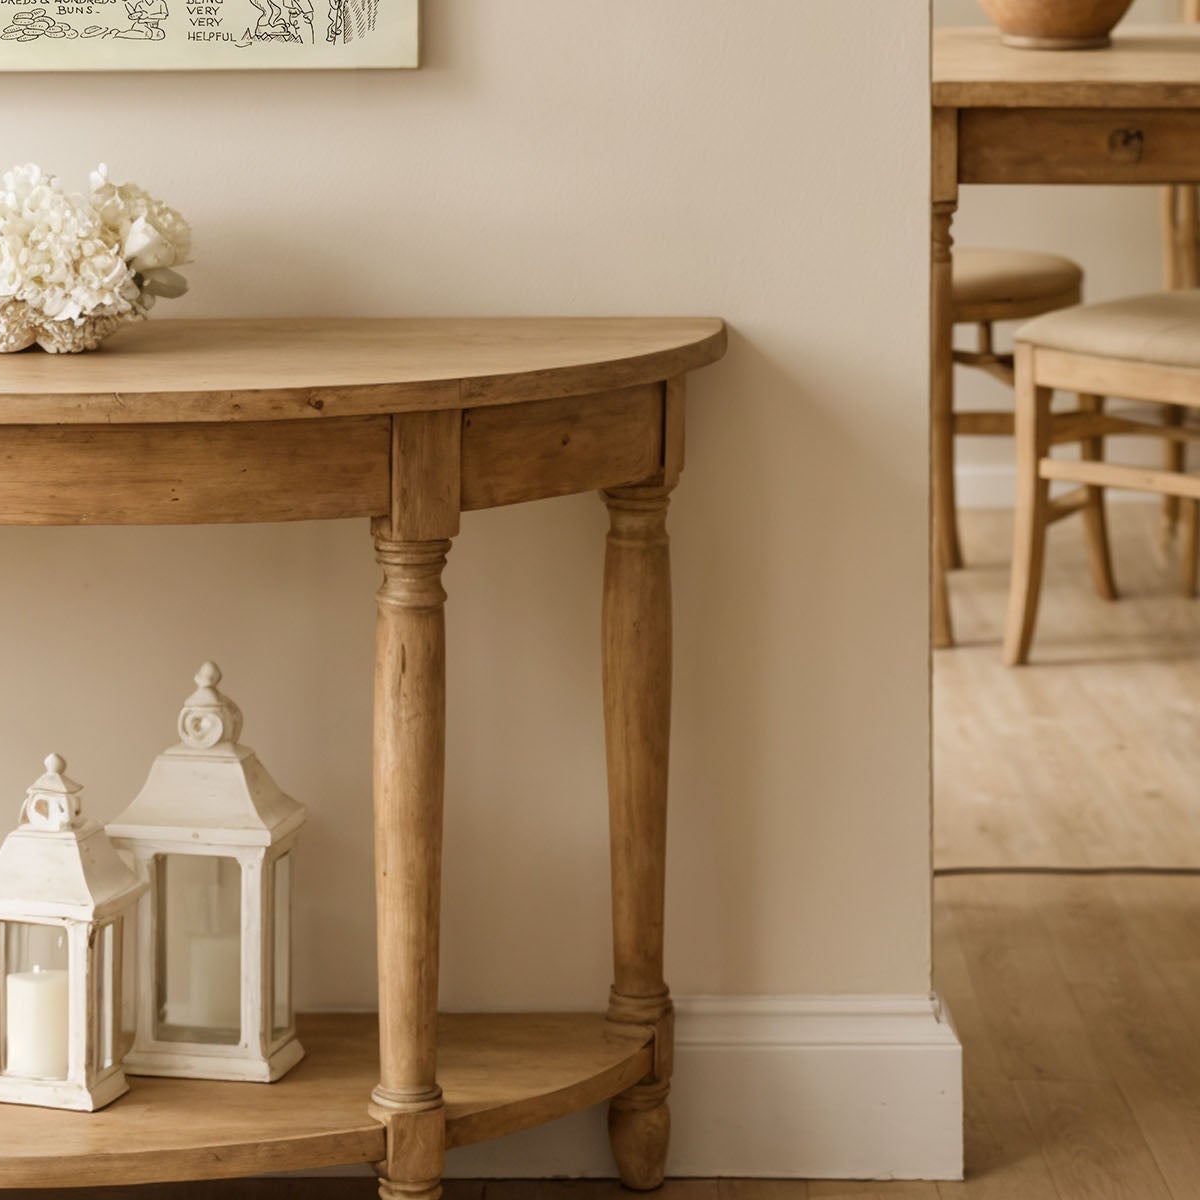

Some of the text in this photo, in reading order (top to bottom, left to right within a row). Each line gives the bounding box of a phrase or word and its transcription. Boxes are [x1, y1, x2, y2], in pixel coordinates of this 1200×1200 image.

[186, 6, 220, 16] VERY
[189, 17, 223, 27] VERY
[188, 31, 236, 42] HELPFUL
